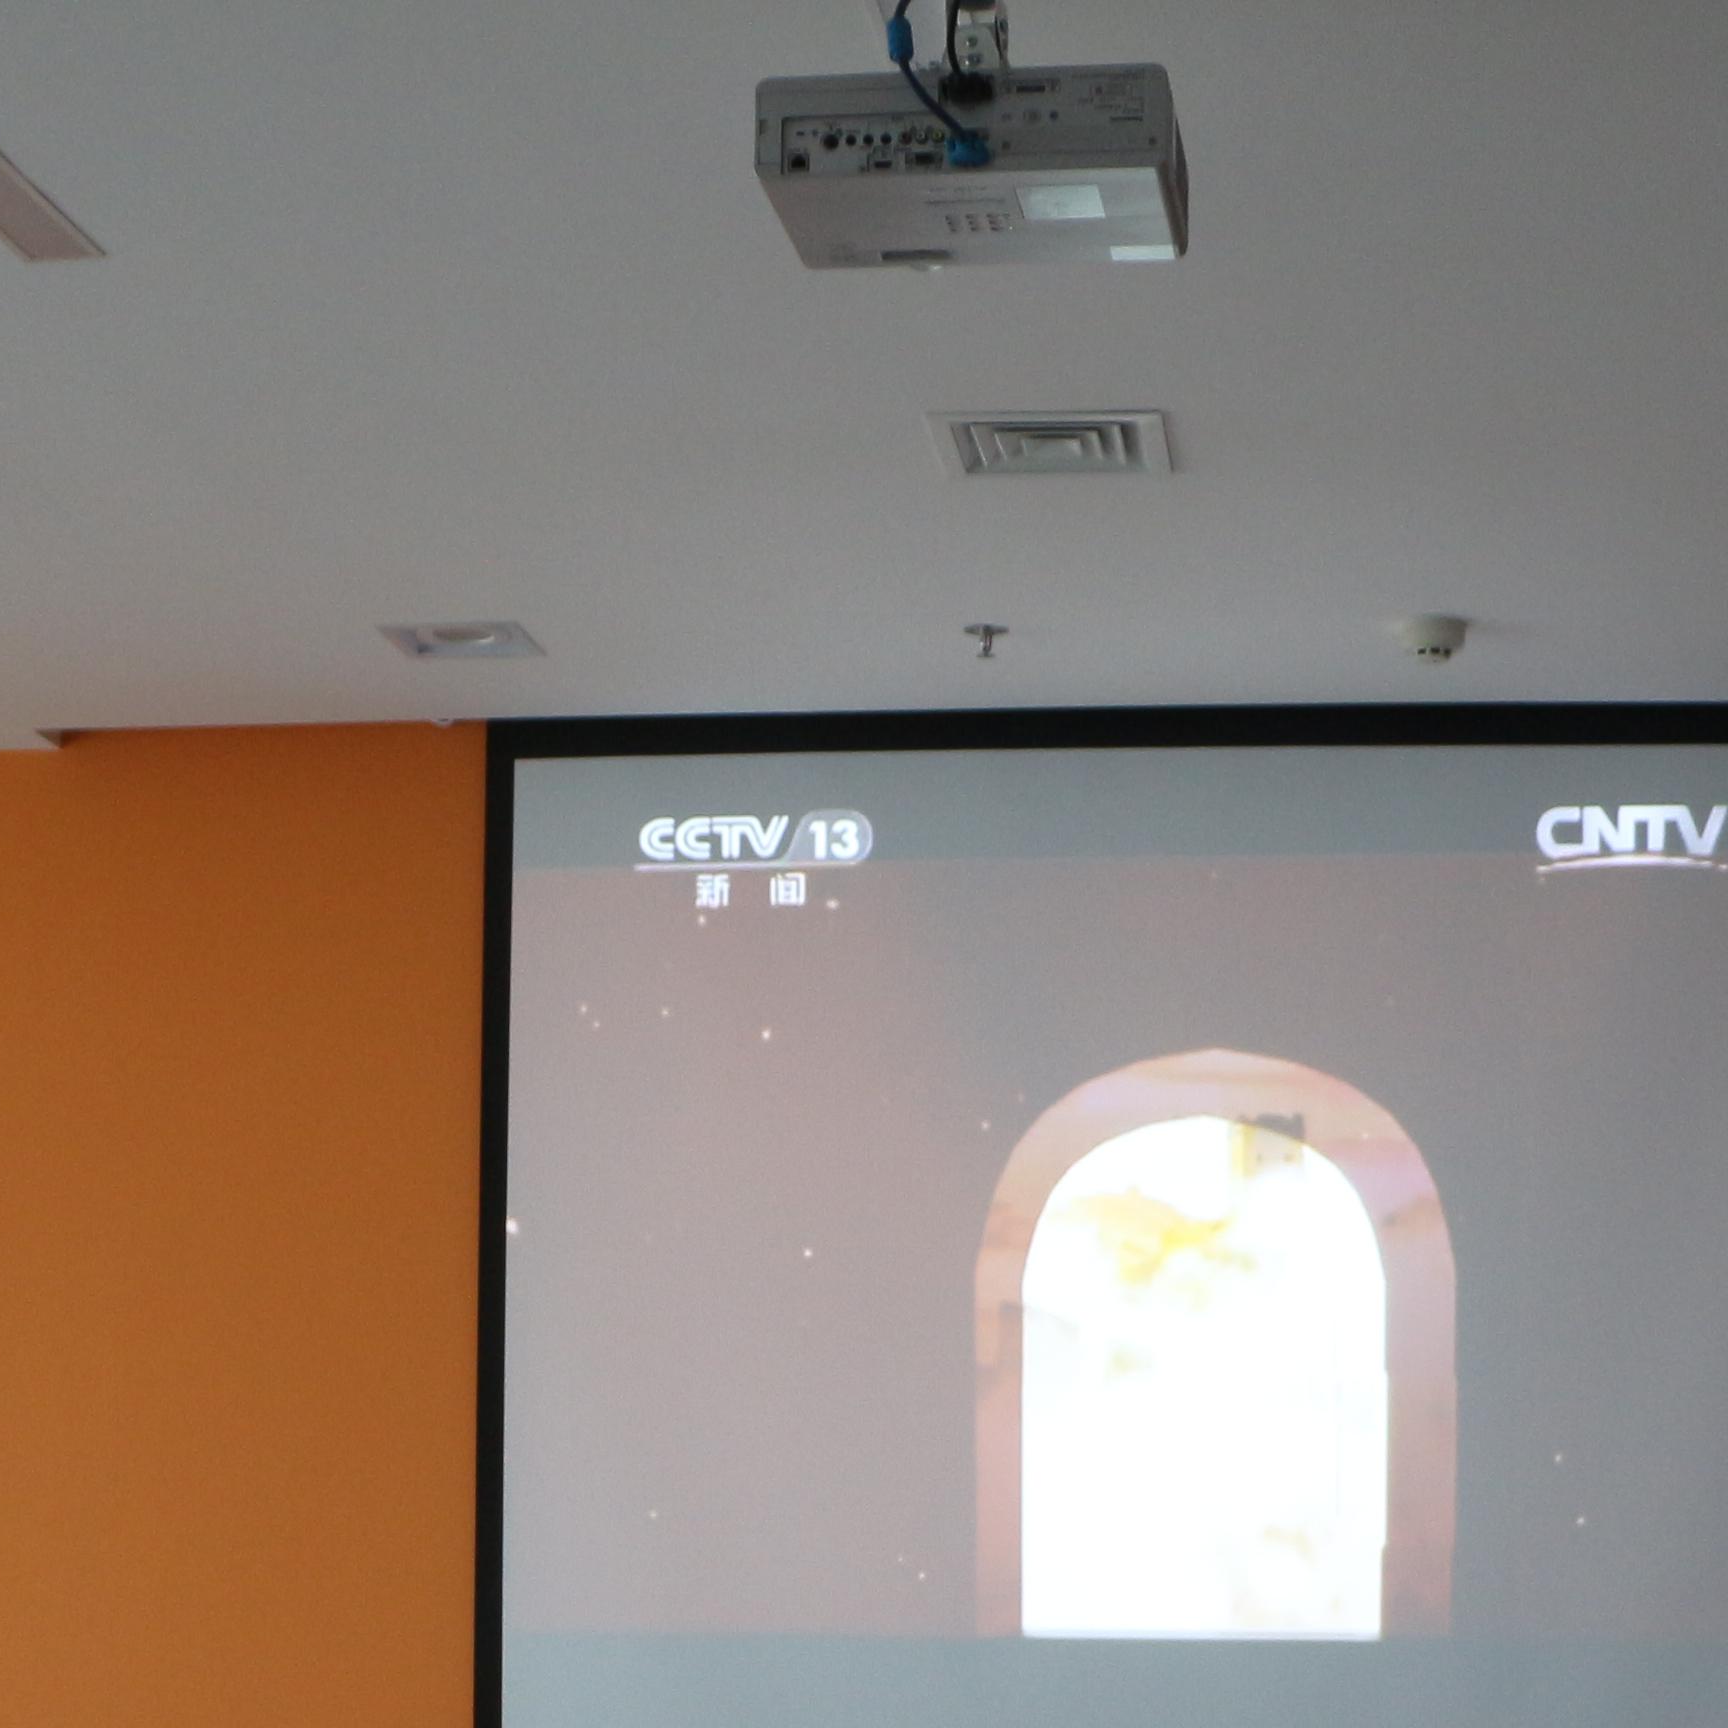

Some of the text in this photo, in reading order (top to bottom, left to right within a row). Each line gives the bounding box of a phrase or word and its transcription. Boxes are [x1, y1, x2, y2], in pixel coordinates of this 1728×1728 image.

[638, 814, 860, 862] CCTV 13
[1536, 804, 1728, 860] CNTV
